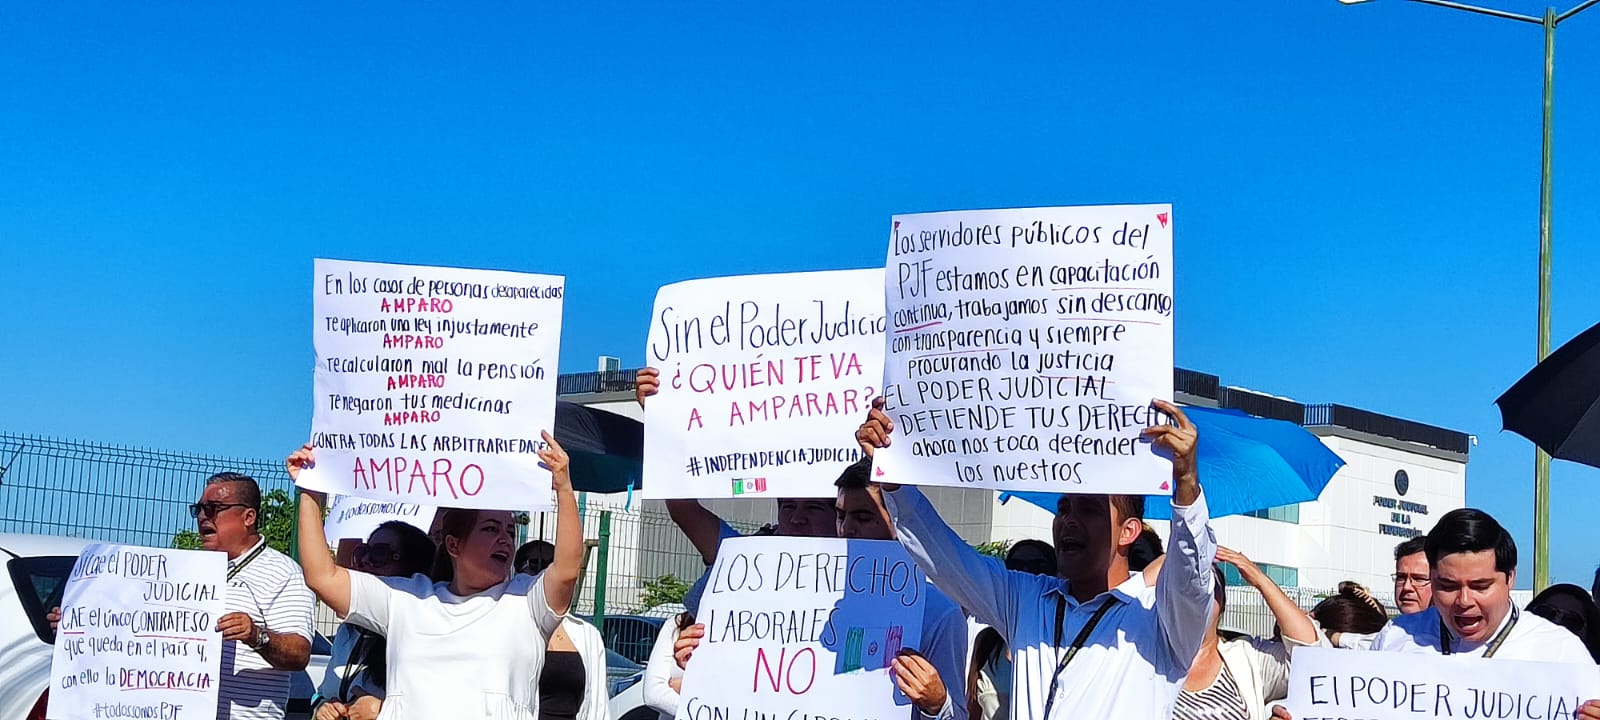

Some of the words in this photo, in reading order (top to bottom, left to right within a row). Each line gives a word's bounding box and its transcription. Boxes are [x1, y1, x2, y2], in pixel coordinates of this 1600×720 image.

[894, 229, 915, 256] Los
[918, 221, 1001, 252] servidores
[1011, 220, 1101, 248] públicos
[1112, 222, 1150, 250] del
[326, 274, 342, 296] En
[349, 271, 367, 295] los
[373, 279, 403, 294] casos
[406, 276, 425, 295] de
[428, 280, 489, 299] personas
[491, 283, 563, 299] desaparecidas
[899, 258, 933, 299] PJF
[935, 265, 1009, 292] estamos
[1016, 264, 1044, 287] en
[1050, 255, 1160, 285] capacitación
[380, 298, 453, 314] AMPARO
[894, 302, 952, 328] continua,
[958, 298, 1048, 321] trabajamos
[1057, 295, 1087, 314] sin
[383, 333, 444, 349] AMPARO
[391, 318, 410, 332] una
[414, 318, 432, 335] ley
[437, 319, 539, 339] injustamente
[653, 306, 702, 361] Sin
[710, 301, 730, 345] el
[740, 301, 808, 350] Poder
[811, 300, 887, 344] Judicia
[892, 333, 911, 353] con
[914, 326, 1023, 352] transparencia
[1029, 328, 1040, 349] y
[1046, 323, 1126, 345] siempre
[422, 358, 447, 375] mal
[457, 358, 473, 377] la
[478, 358, 544, 381] pensión
[672, 354, 784, 394] ¿QUIÉN
[794, 355, 822, 383] TE
[830, 352, 863, 380] VA
[908, 353, 1001, 379] procurando
[1011, 352, 1029, 370] la
[1037, 350, 1114, 377] justicia
[387, 374, 445, 391] AMPARO
[884, 383, 910, 411] EL
[917, 378, 992, 404] PODER
[999, 375, 1116, 401] JUDICIAL
[384, 410, 440, 426] AMPARO
[400, 393, 426, 411] tus
[431, 393, 513, 415] medicinas
[687, 408, 703, 431] A
[730, 386, 875, 427] AMPARAR?
[899, 404, 1017, 437] DEFIENDE
[1025, 405, 1070, 430] TUS
[312, 433, 357, 450] CONTRA
[359, 432, 395, 449] TODAS
[400, 433, 427, 451] LAS
[912, 437, 956, 458] ahora
[962, 437, 989, 454] nos
[993, 435, 1039, 453] toca
[1049, 433, 1143, 456] defender
[353, 456, 485, 500] AMPARO
[955, 461, 984, 483] los
[993, 459, 1082, 484] nuestros
[107, 551, 120, 575] el
[123, 551, 167, 580] PODER
[712, 553, 764, 594] LOS
[774, 551, 918, 607] DERECHOS
[143, 581, 219, 601] JUDICIAL
[62, 605, 86, 631] CAE
[89, 607, 101, 628] el
[131, 610, 209, 634] CONTRAPESO
[709, 607, 840, 647] LABORALES
[63, 636, 85, 661] que
[88, 635, 123, 656] queda
[127, 639, 142, 656] en
[145, 639, 157, 656] el
[162, 640, 189, 659] país
[61, 673, 78, 689] con
[79, 668, 99, 684] ello
[105, 666, 116, 684] la
[119, 667, 214, 689] DEMOCRACIA
[753, 647, 816, 695] NO
[1351, 676, 1452, 717] PODER
